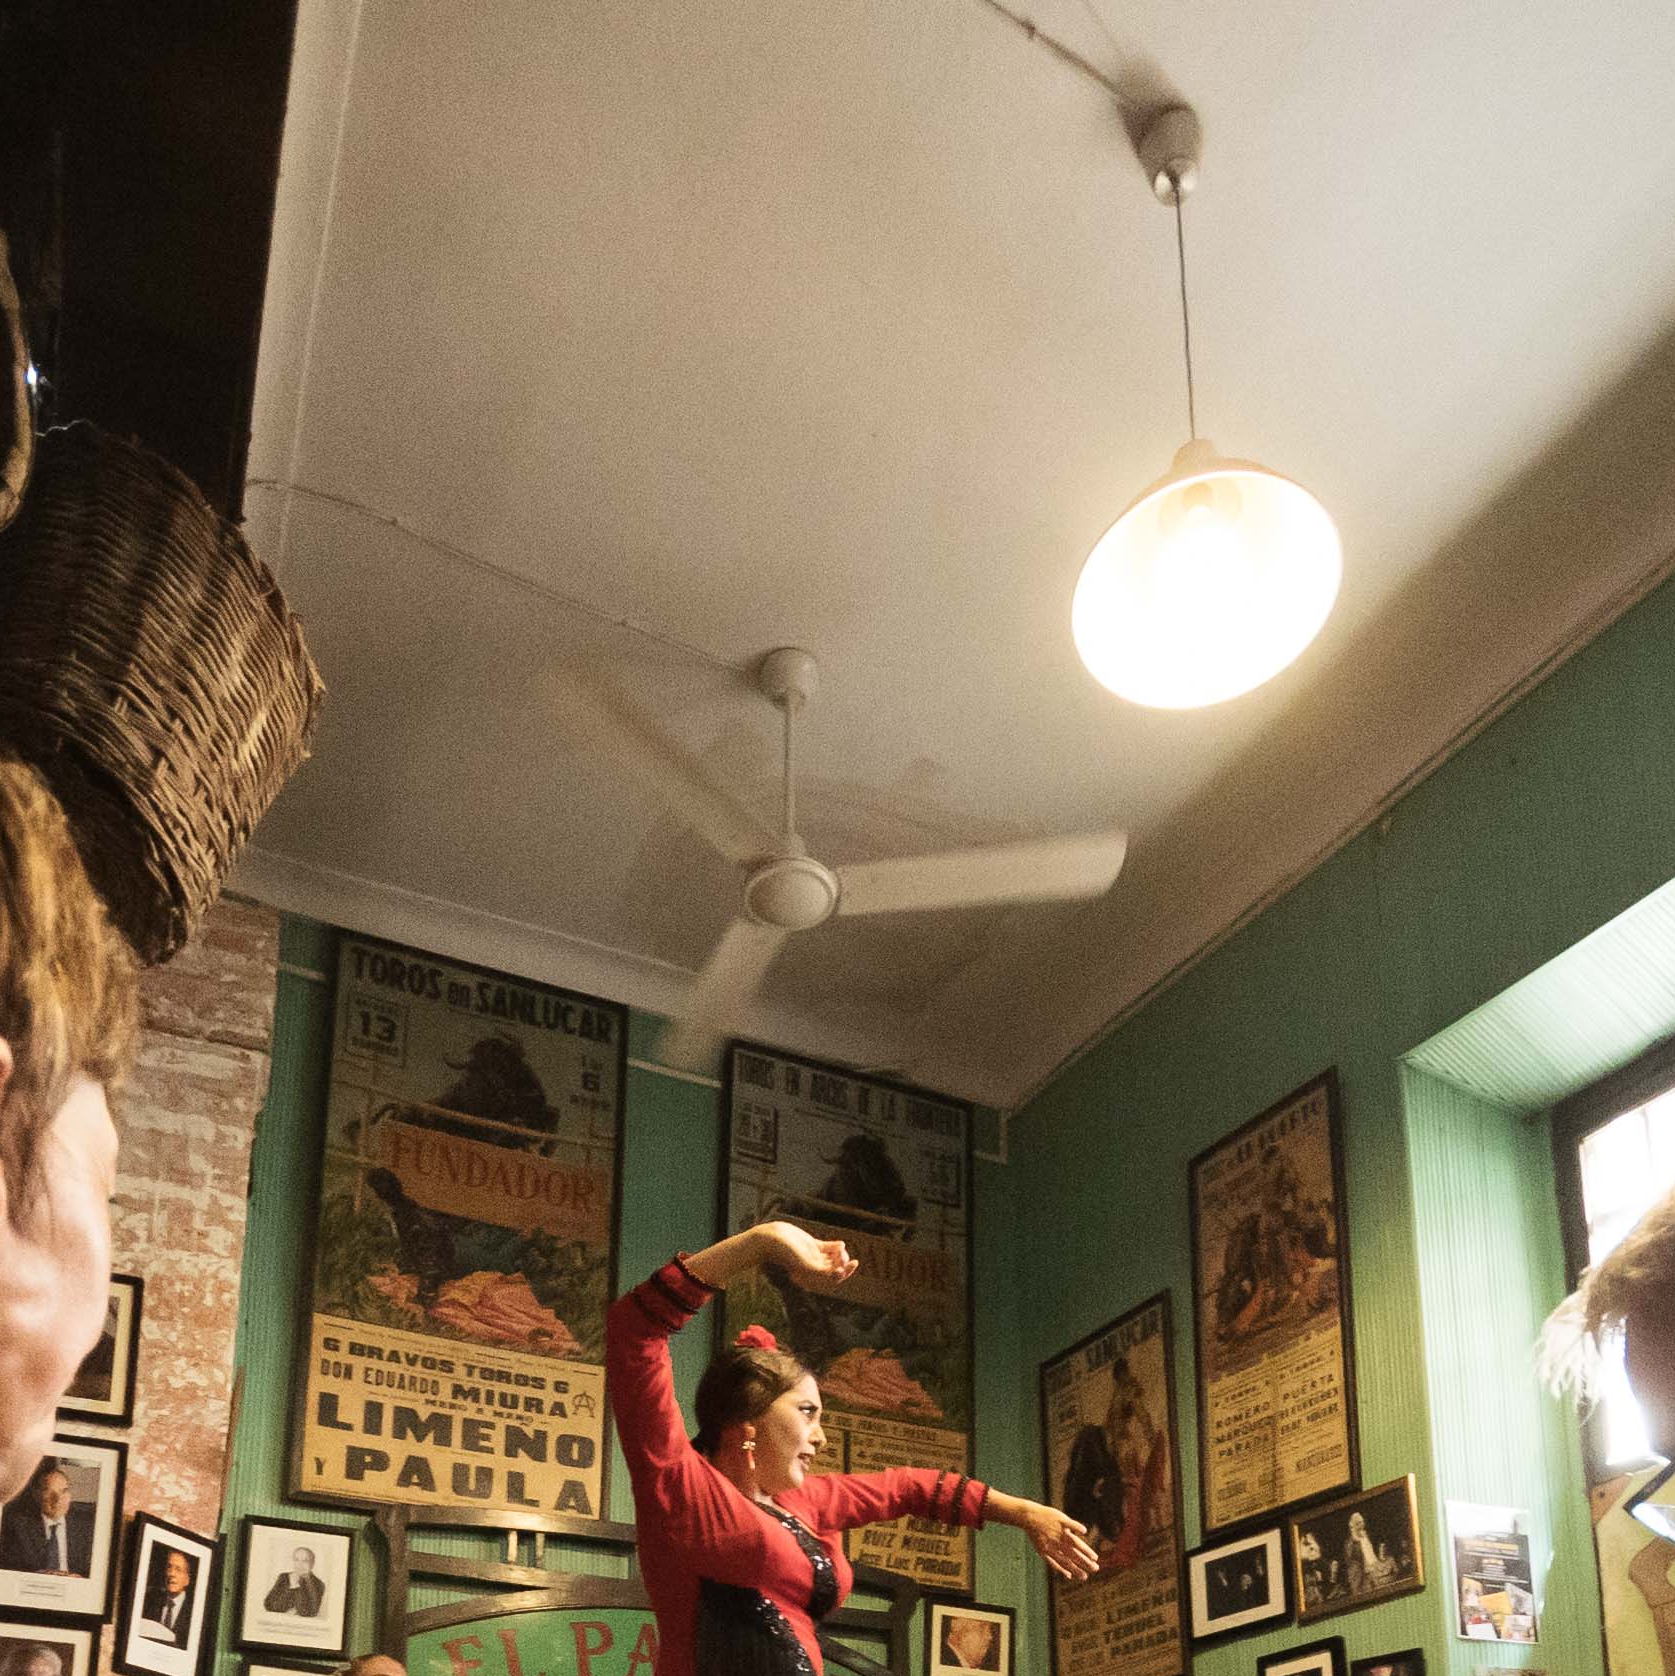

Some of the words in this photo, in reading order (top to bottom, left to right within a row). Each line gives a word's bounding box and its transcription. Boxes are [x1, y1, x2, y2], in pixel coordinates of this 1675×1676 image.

[352, 949, 445, 999] TOROS
[474, 980, 613, 1044] SANLUCAR
[358, 1010, 398, 1043] 13
[390, 1130, 595, 1211] FUNDADOR
[851, 1242, 956, 1293] ADOR
[320, 1358, 353, 1381] DON
[363, 1367, 441, 1396] EDUARDO
[451, 1382, 569, 1419] MIURA
[324, 1337, 341, 1352] 6
[349, 1342, 455, 1374] BRAVOS
[463, 1363, 547, 1390] TOROS
[553, 1381, 570, 1394] 6
[315, 1457, 327, 1476] Y
[345, 1445, 594, 1516] PAULA
